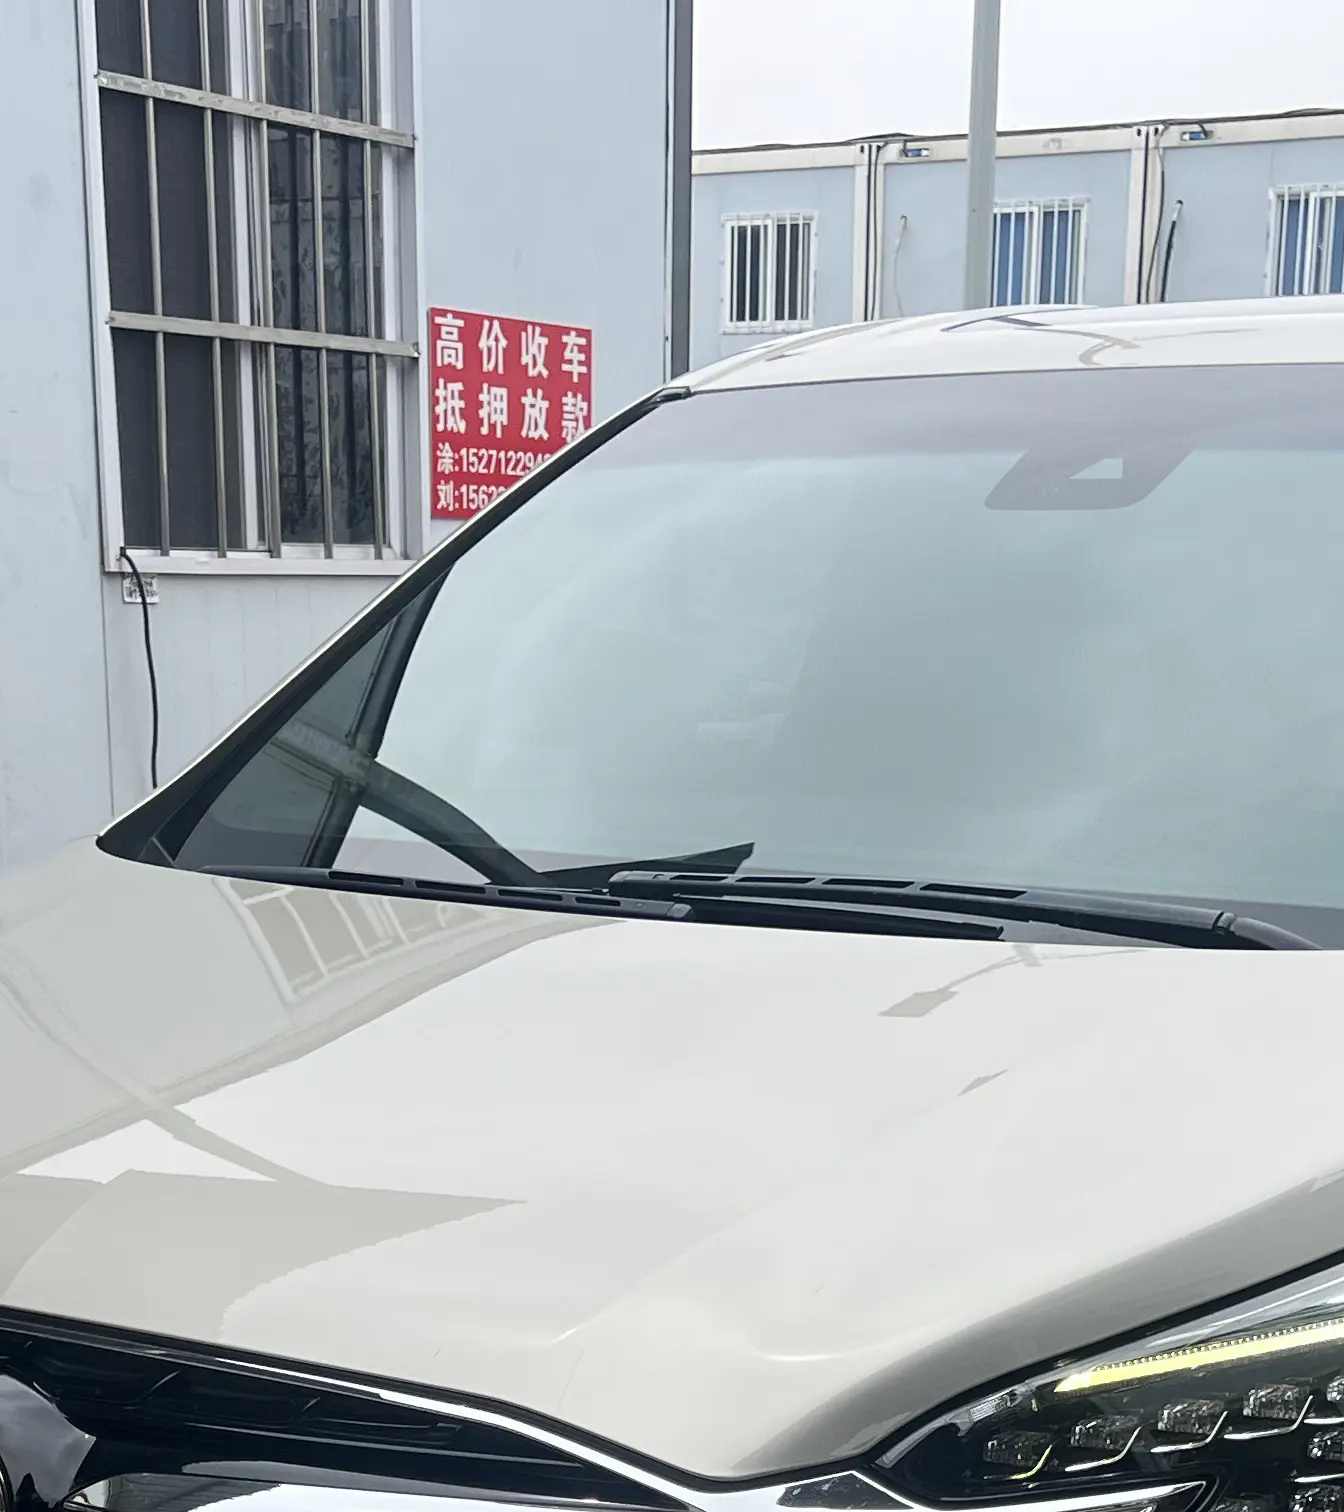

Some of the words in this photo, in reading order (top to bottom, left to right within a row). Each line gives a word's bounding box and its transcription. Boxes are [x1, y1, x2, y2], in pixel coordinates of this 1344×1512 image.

[434, 313, 588, 383] 高价收车
[435, 378, 588, 444] 抵押放款
